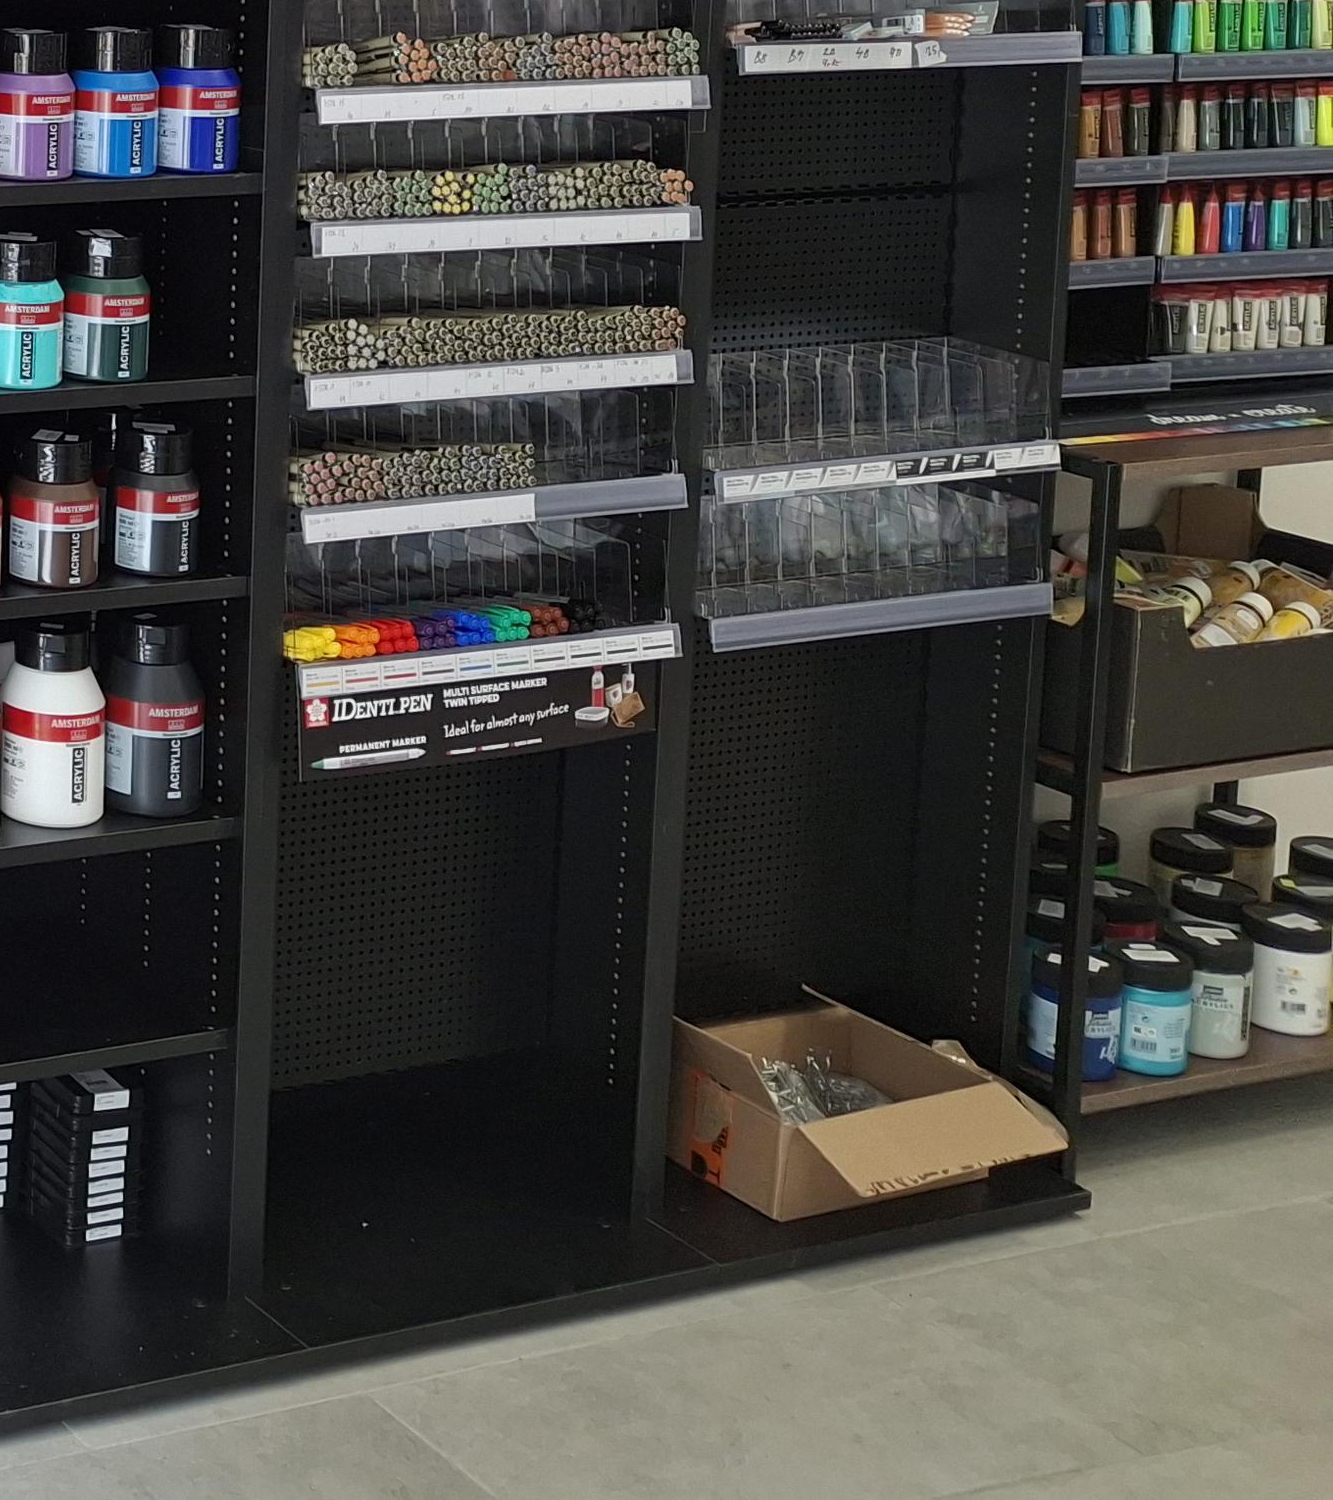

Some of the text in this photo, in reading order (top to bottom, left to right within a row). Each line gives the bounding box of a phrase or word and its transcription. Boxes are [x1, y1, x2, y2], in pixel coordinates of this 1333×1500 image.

[22, 333, 32, 378] ACRYLIC
[443, 677, 548, 698] MULTI SURFACE MARKER
[443, 694, 500, 709] TWIN TIPPED
[51, 716, 101, 730] AMSTERDAM
[148, 707, 199, 718] AMSTERDAM
[443, 702, 570, 738] Ideal for almost any surface
[339, 736, 427, 754] PERMANENT MARKER
[169, 739, 182, 790] ACRYLIC
[72, 749, 83, 802] ACRYLIC
